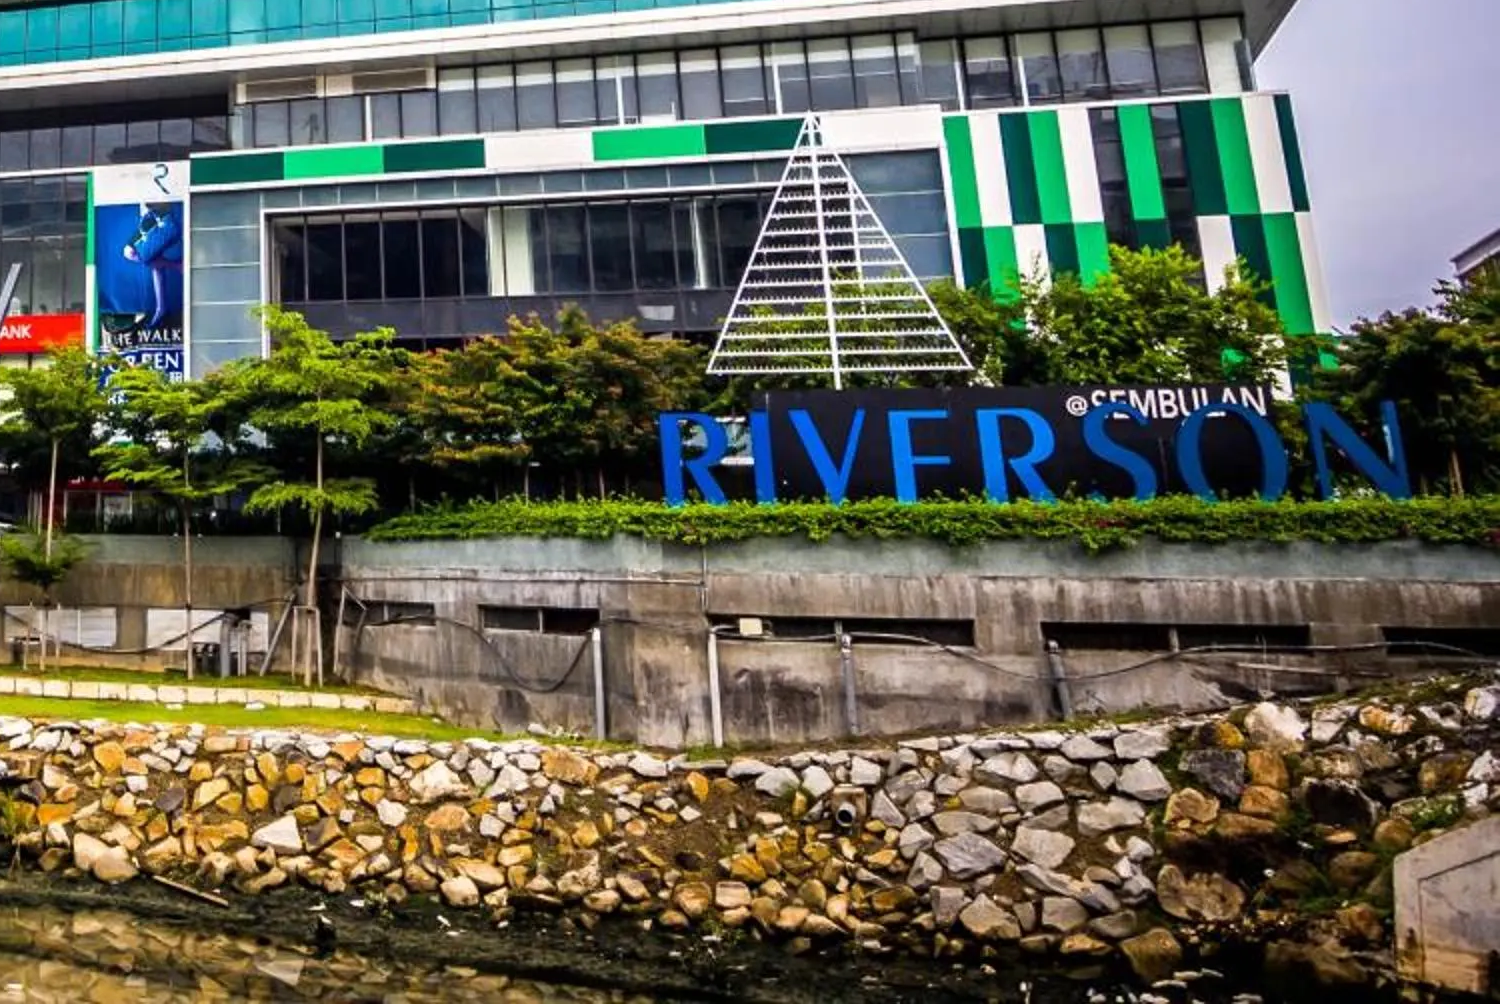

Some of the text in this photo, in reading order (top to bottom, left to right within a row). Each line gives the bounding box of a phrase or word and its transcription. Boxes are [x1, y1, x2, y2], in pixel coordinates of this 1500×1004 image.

[137, 328, 182, 343] WALK
[140, 351, 185, 370] REN
[1065, 386, 1268, 420] @SEMBULAN
[658, 399, 1414, 508] RIVERSON
